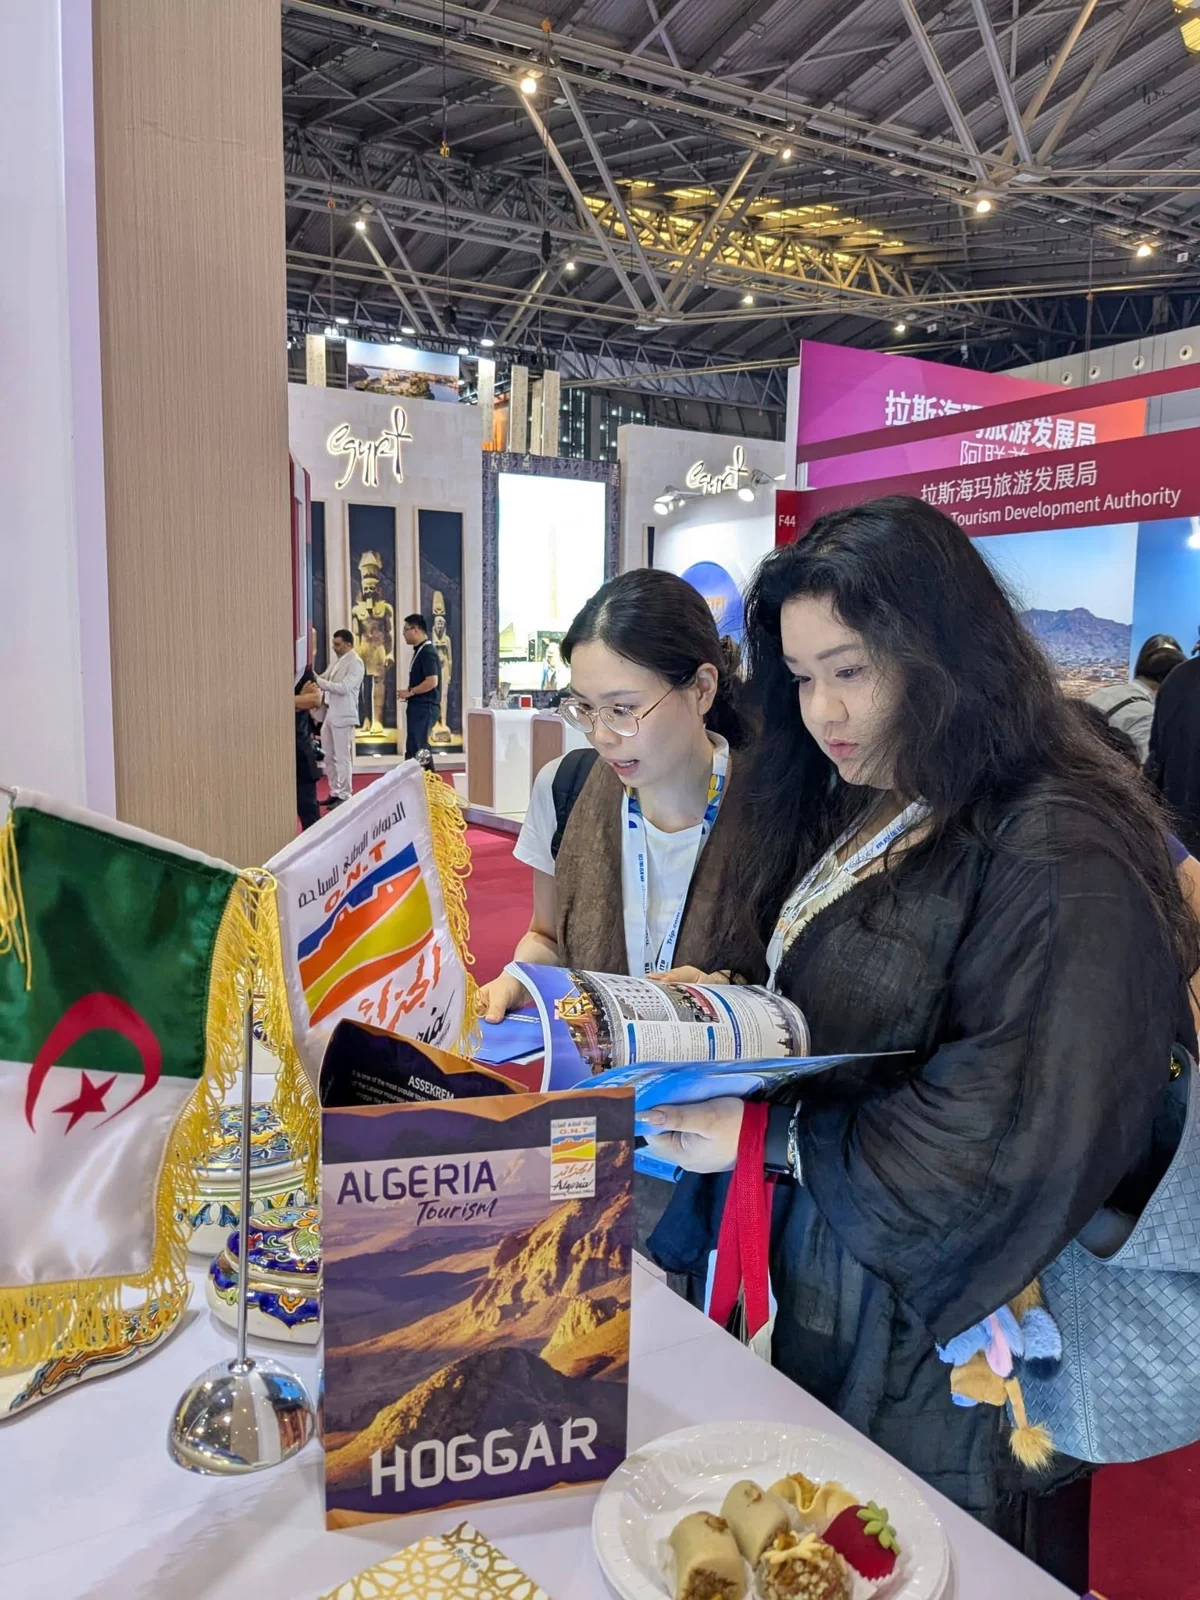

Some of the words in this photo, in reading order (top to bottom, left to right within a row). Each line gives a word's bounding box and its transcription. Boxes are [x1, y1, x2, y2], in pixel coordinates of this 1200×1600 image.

[920, 460, 1097, 505] 拉斯海玛旅游发展局
[778, 514, 796, 528] F44
[951, 507, 1001, 527] Tourism
[1004, 496, 1101, 521] Development
[1103, 487, 1181, 510] Authority
[408, 1075, 455, 1101] ASSEKREM
[336, 1158, 498, 1205] ALGERIA
[415, 1198, 499, 1226] Tourism
[369, 1416, 599, 1497] HOGGAR
